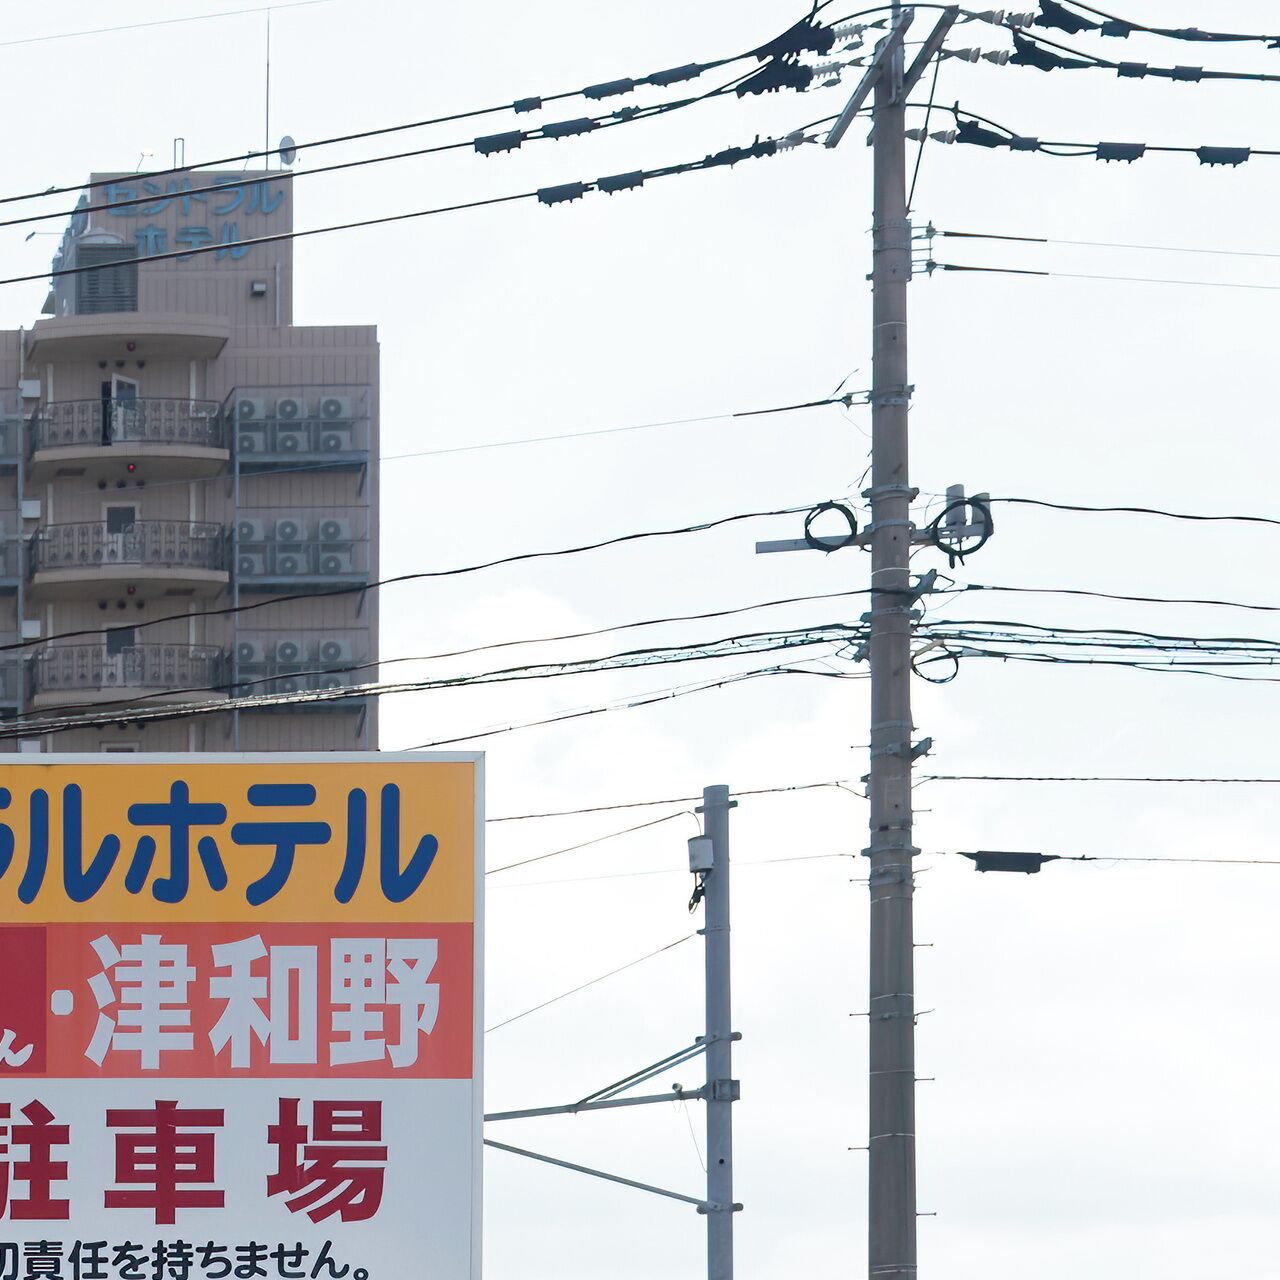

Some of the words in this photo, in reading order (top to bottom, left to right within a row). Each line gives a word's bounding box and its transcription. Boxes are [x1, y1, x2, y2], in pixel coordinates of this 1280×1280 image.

[103, 176, 285, 217] セントラル
[134, 221, 253, 263] ホテル
